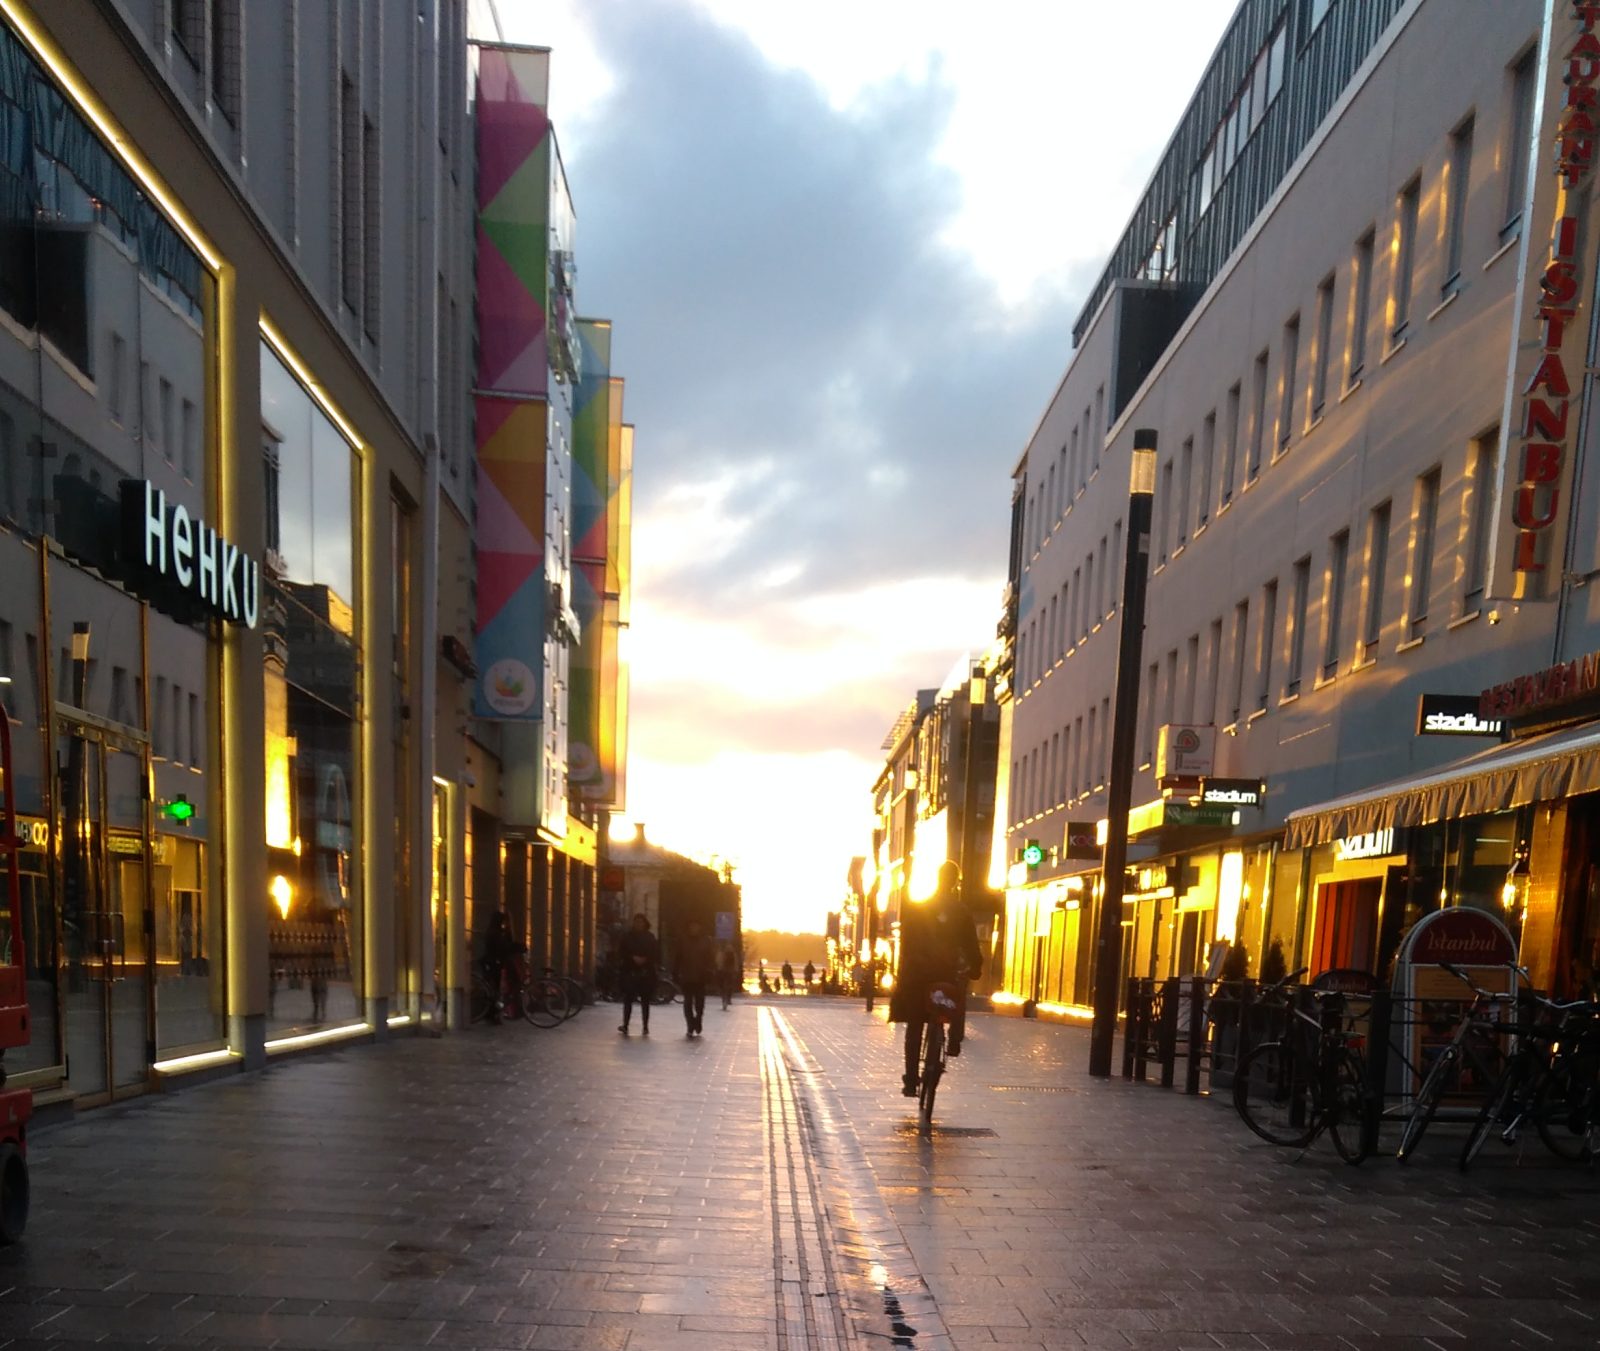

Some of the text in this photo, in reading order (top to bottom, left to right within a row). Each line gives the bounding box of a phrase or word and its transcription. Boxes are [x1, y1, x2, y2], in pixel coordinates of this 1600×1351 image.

[1515, 0, 1600, 572] TAURANT ISTANBUL
[1425, 712, 1501, 732] stadium
[1204, 789, 1257, 803] stadium
[1427, 927, 1497, 952] Istanbul
